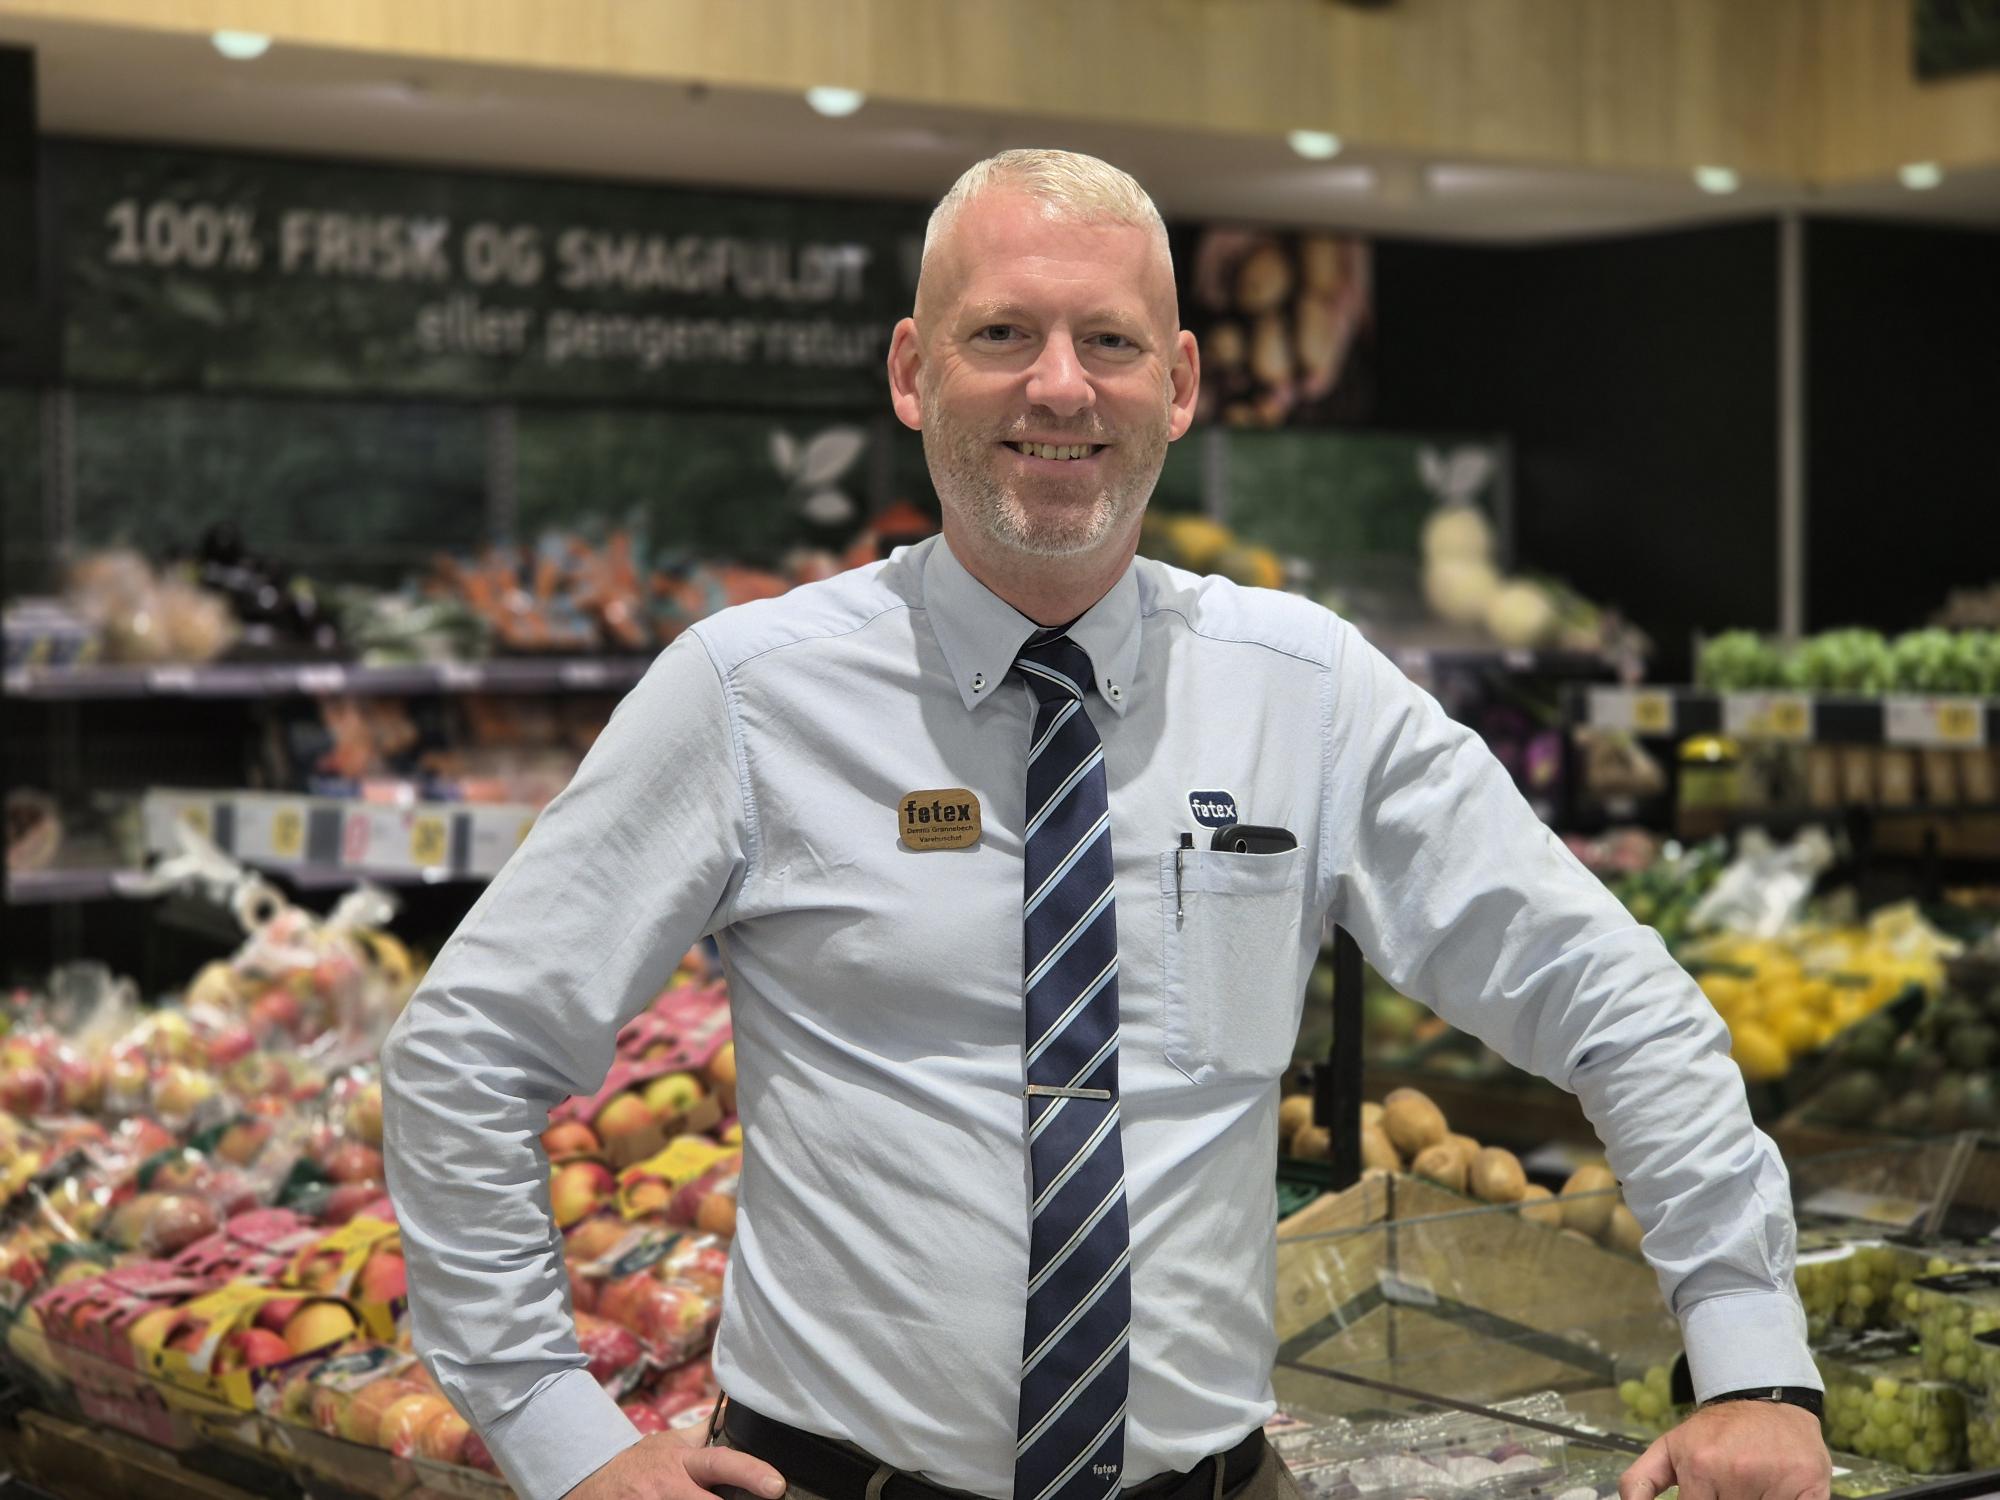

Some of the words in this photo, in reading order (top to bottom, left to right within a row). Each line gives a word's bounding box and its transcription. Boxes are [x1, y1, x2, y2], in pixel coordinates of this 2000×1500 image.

[105, 202, 259, 266] 100%
[280, 209, 449, 281] FRISK
[464, 223, 544, 286] OG
[557, 229, 868, 300] SMAGFULDT
[417, 297, 527, 354] eller
[546, 311, 755, 367] pengene
[765, 322, 884, 366] retur
[1192, 799, 1236, 818] føtex
